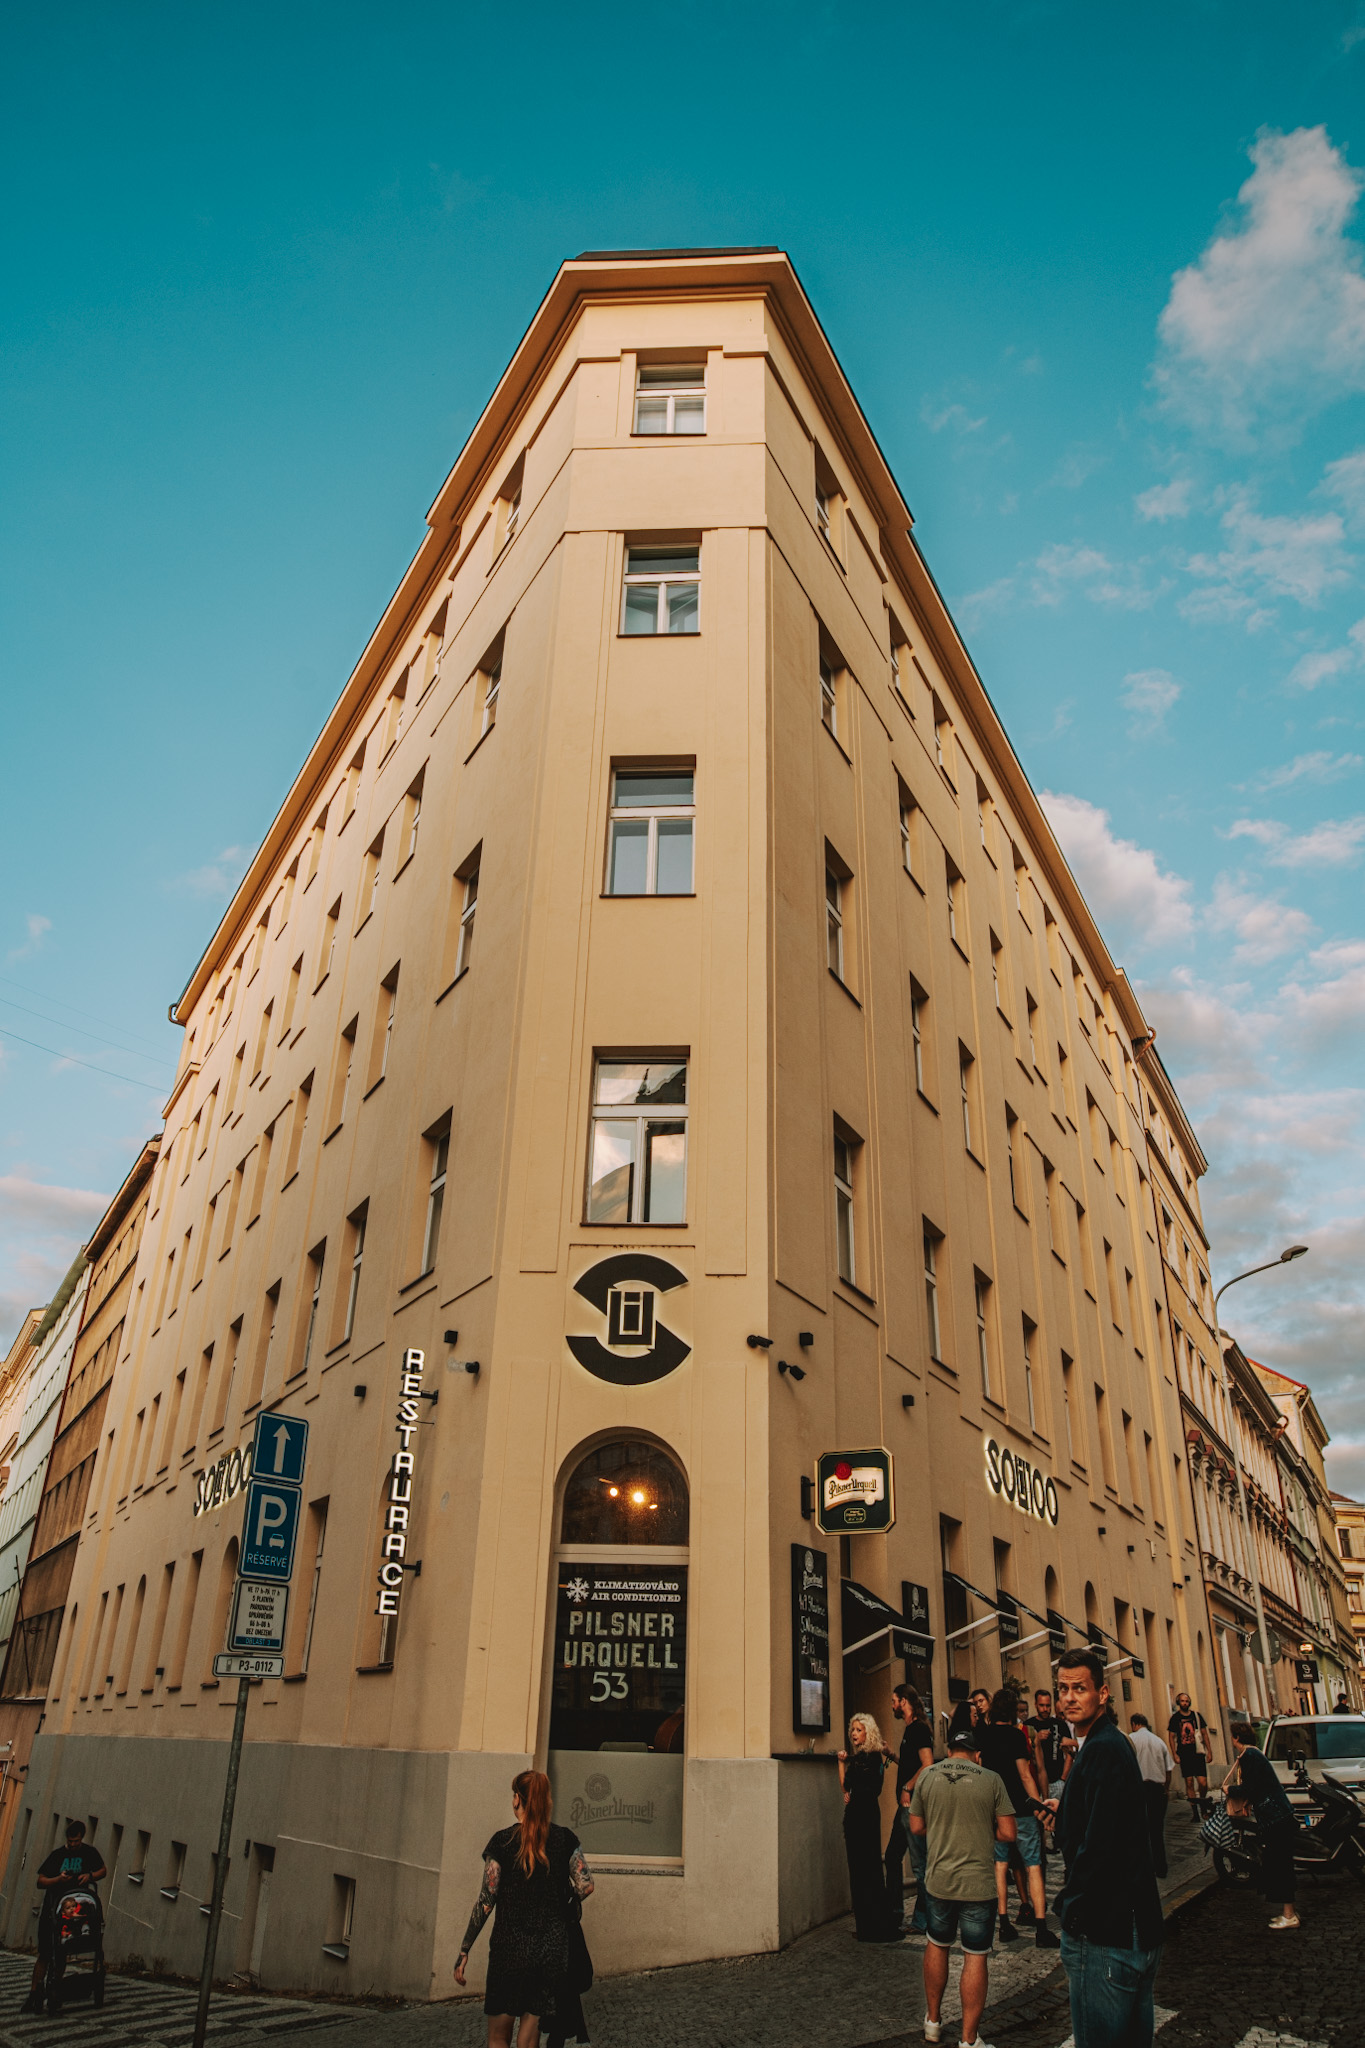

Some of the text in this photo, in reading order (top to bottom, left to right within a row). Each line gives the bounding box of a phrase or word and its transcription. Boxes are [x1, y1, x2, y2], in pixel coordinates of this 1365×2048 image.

[377, 1348, 425, 1615] RESTAURACE
[829, 1478, 877, 1499] Pilsner Urquell
[255, 1494, 287, 1546] P
[247, 1551, 287, 1568] RÉSERVÉ
[591, 1592, 681, 1603] AIR CONDITIONED
[594, 1580, 679, 1591] KLIMATIZOVÁNO
[569, 1610, 675, 1637] PILSNER
[238, 1660, 274, 1672] P3-0112
[563, 1641, 679, 1669] URQUELL
[589, 1671, 629, 1703] 53
[570, 1796, 655, 1829] Pilsner Urquell
